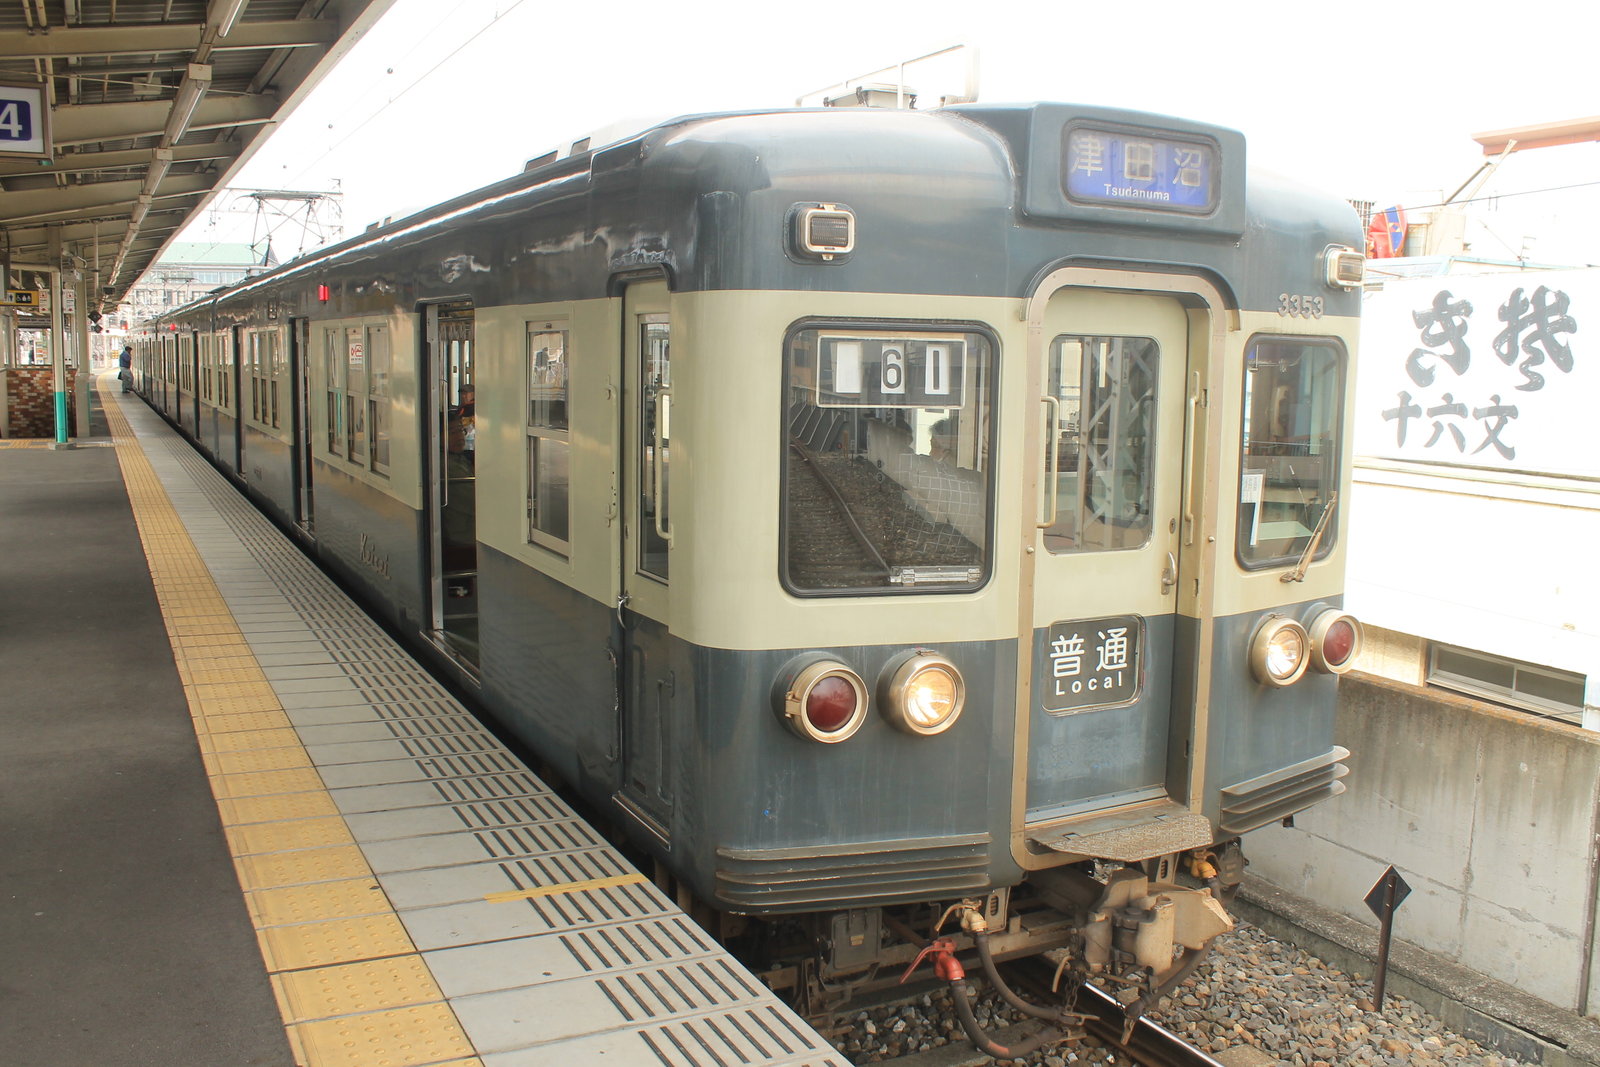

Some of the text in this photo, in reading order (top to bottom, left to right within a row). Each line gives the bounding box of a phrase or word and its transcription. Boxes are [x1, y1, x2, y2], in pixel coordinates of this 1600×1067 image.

[0, 102, 23, 138] 4
[1071, 135, 1201, 187] 津田沼
[1103, 183, 1170, 201] Tsudanuma
[1278, 293, 1324, 320] 3353
[1381, 390, 1519, 461] 十六文
[1050, 627, 1128, 677] 普通
[1055, 671, 1122, 695] Local
